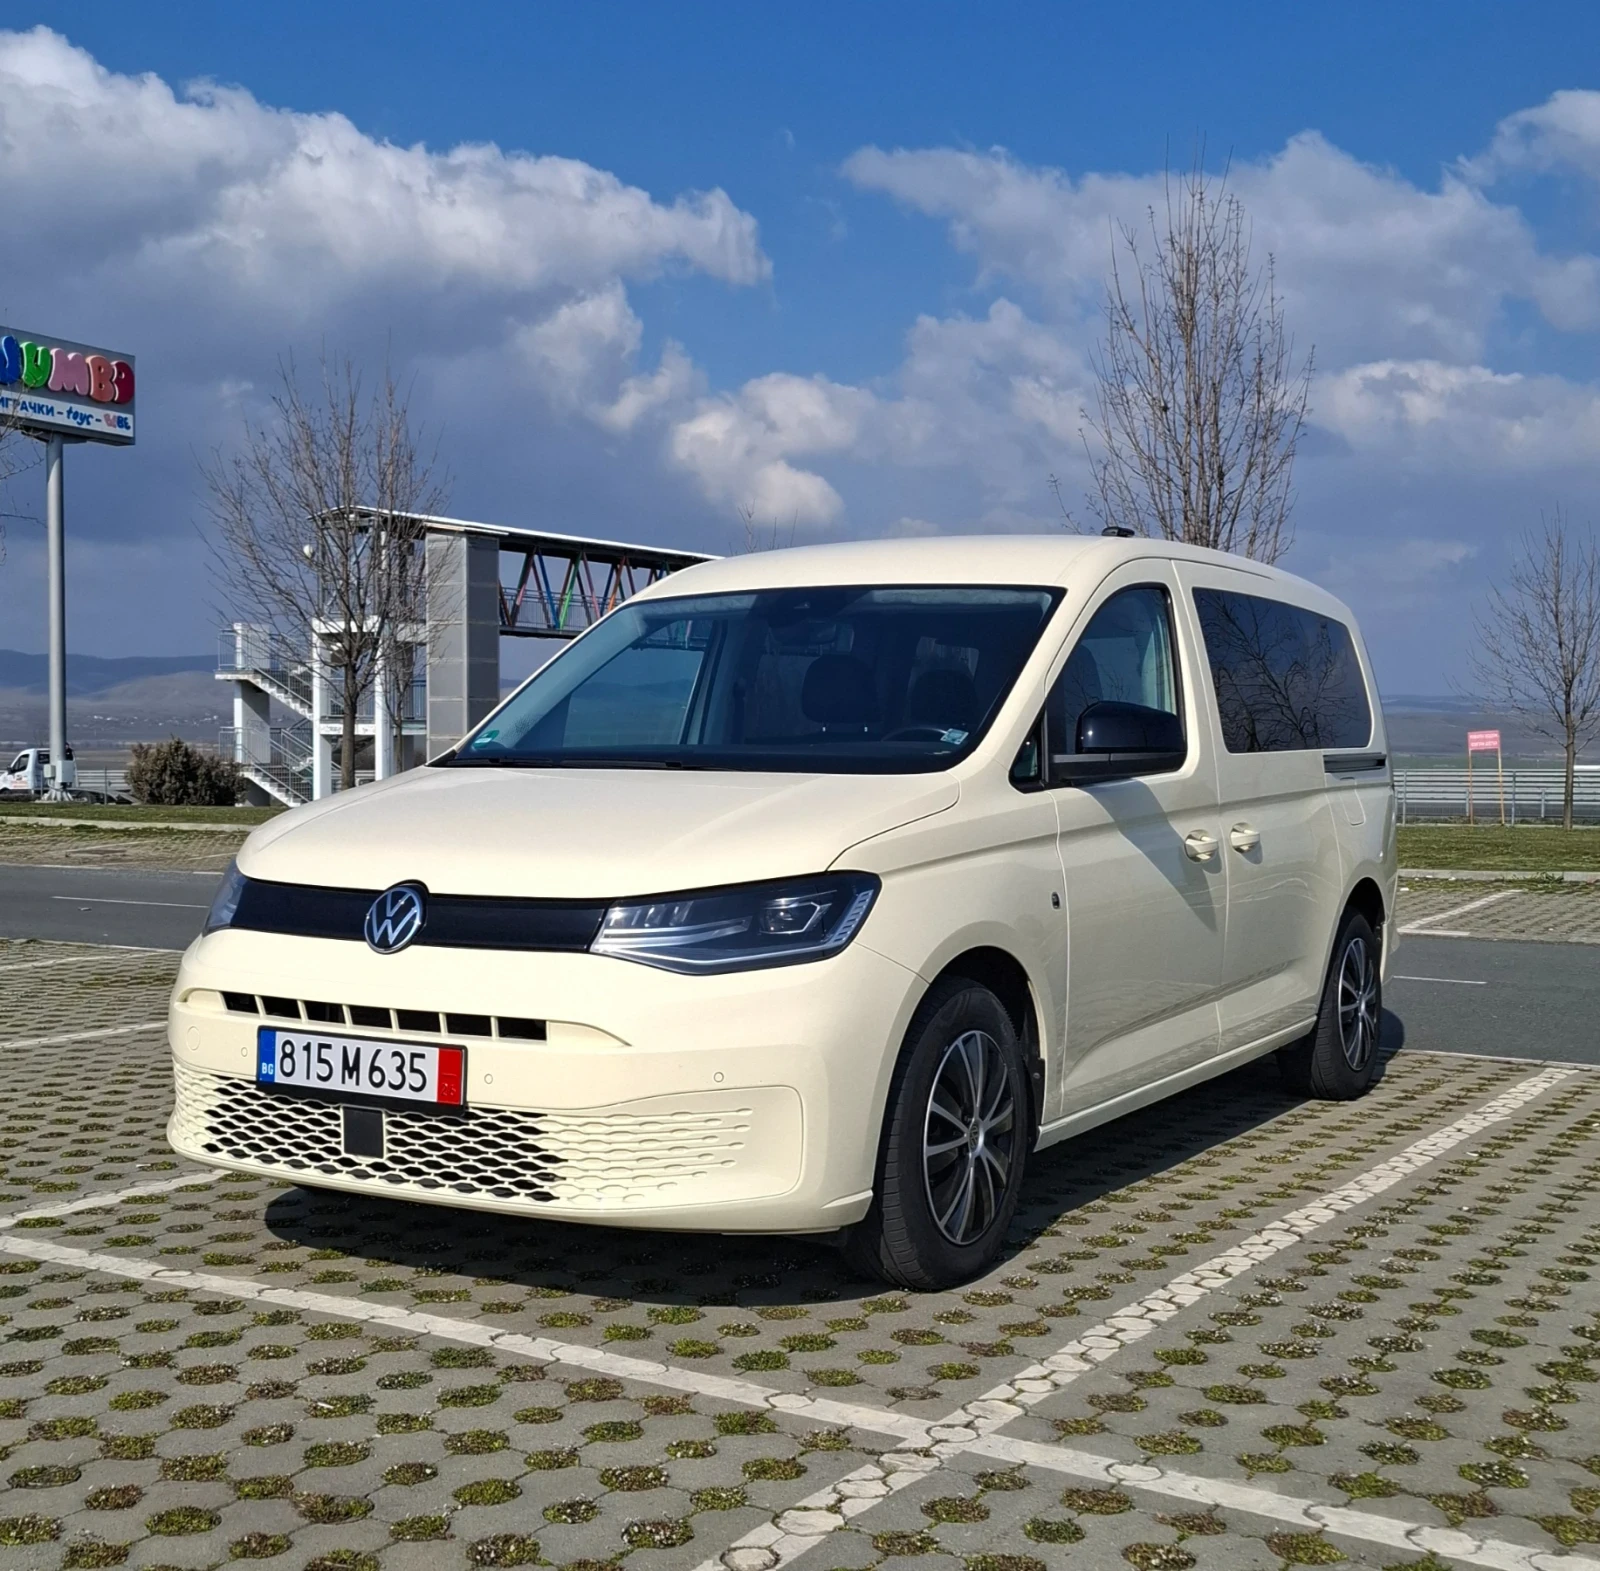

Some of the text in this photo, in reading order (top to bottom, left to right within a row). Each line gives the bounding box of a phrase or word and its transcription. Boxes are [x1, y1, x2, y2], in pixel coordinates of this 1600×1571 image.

[0, 335, 135, 404] JUMBO
[66, 406, 94, 426] toys
[261, 1062, 274, 1075] BG
